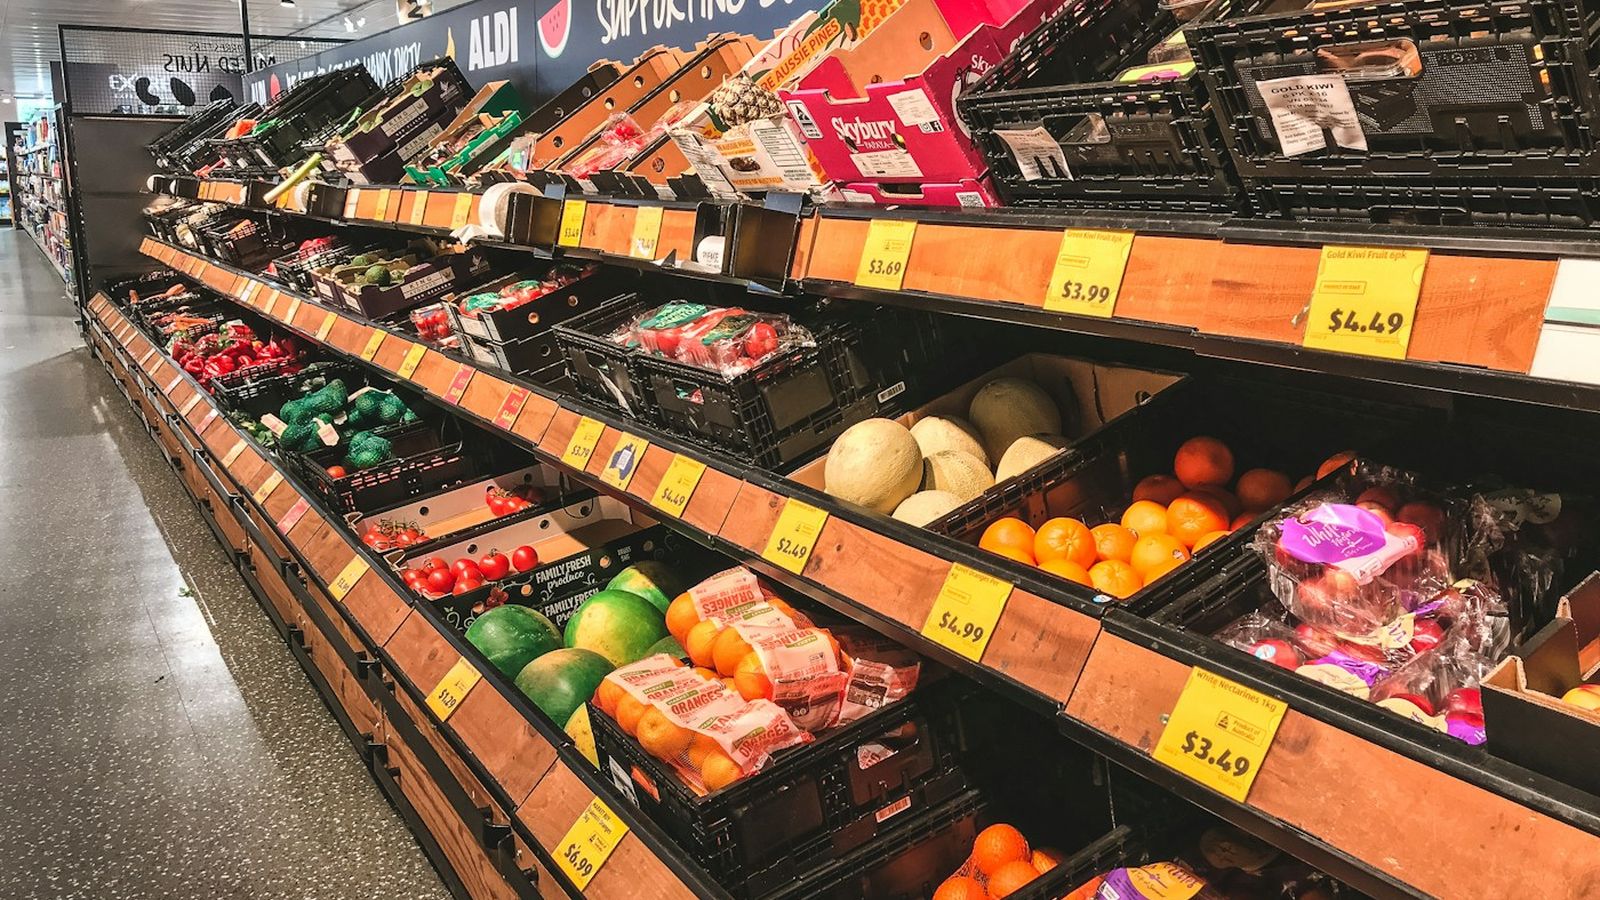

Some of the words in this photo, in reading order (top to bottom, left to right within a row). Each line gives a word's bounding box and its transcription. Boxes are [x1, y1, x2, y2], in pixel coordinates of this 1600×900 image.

[468, 6, 519, 72] ALDI
[775, 45, 810, 79] AUSSIE
[808, 20, 840, 51] PINES
[1271, 84, 1304, 95] GOLD
[1305, 82, 1335, 91] KIWI
[831, 116, 896, 144] Skybury
[863, 141, 889, 149] PAPAYA
[868, 258, 902, 276] $3.69
[1326, 250, 1346, 259] Gold
[1346, 250, 1366, 259] Kiwi
[1367, 250, 1388, 260] Fruit
[409, 276, 432, 289] KING
[1061, 279, 1110, 304] $3.99
[1328, 307, 1404, 335] $4.49
[661, 487, 686, 506] $4.49
[776, 536, 808, 560] $2.49
[535, 563, 566, 584] FAMILY
[565, 554, 592, 574] FRESH
[547, 570, 585, 594] produce
[544, 597, 574, 618] FAMILY
[702, 590, 755, 614] ORANGES
[938, 610, 985, 643] $4.99
[671, 688, 724, 715] ORANGES
[1196, 670, 1218, 685] White
[1218, 680, 1260, 704] Nectarines
[1261, 698, 1278, 713] 1kg
[739, 719, 791, 758] ORANGES
[1180, 729, 1251, 778] $3.49
[563, 843, 594, 877] $6.99
